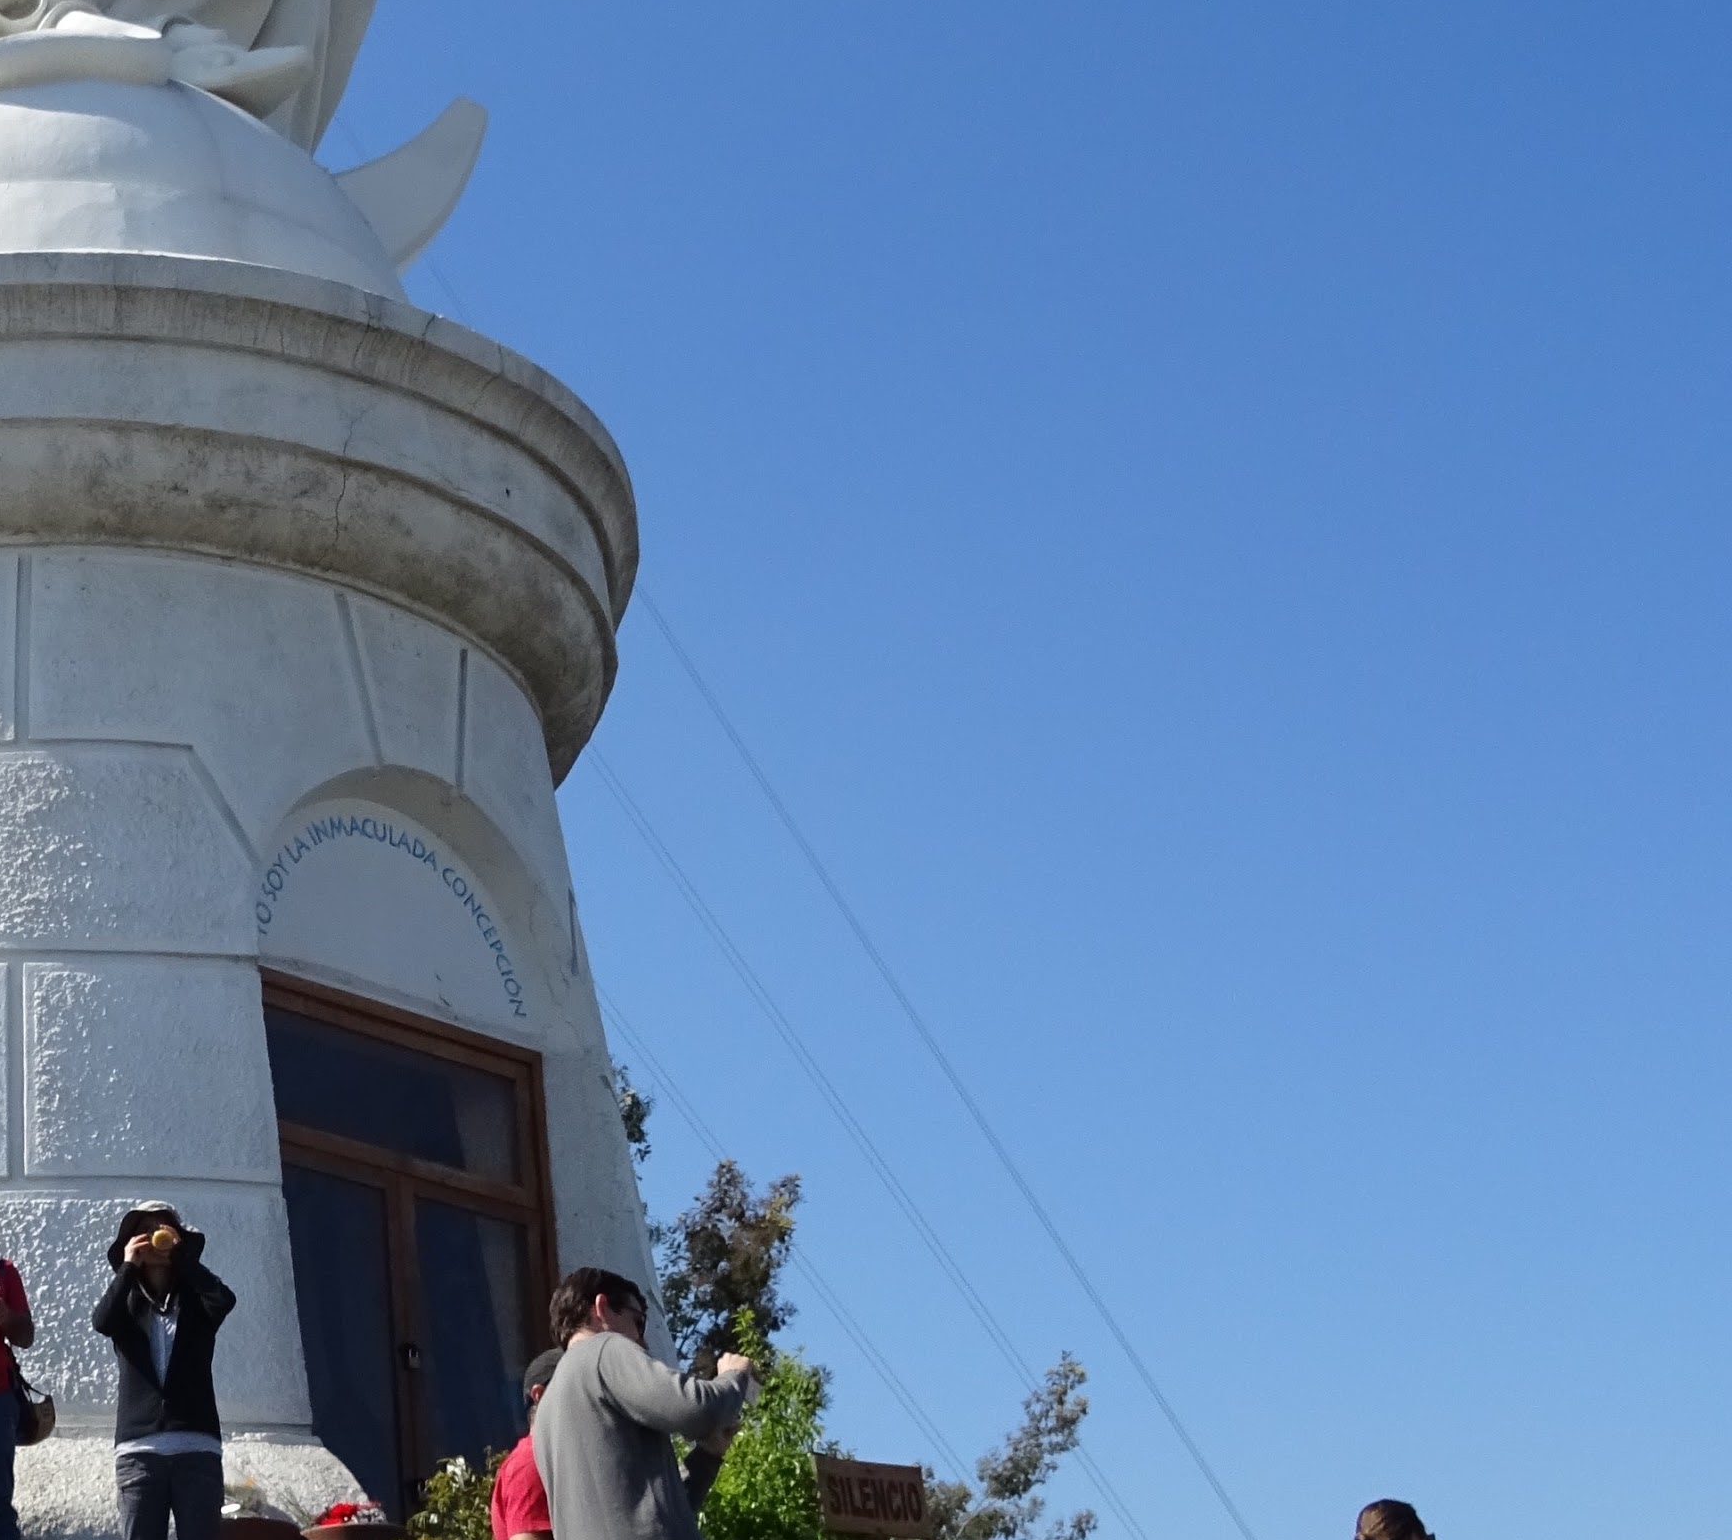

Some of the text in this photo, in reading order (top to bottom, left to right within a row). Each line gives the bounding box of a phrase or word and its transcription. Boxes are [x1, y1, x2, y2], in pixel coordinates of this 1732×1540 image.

[262, 852, 290, 902] SOY
[284, 837, 311, 864] LA
[308, 815, 439, 872] INMACULADA
[442, 867, 527, 1018] CONCEPCIÓN
[827, 1474, 923, 1522] SILENCIO
